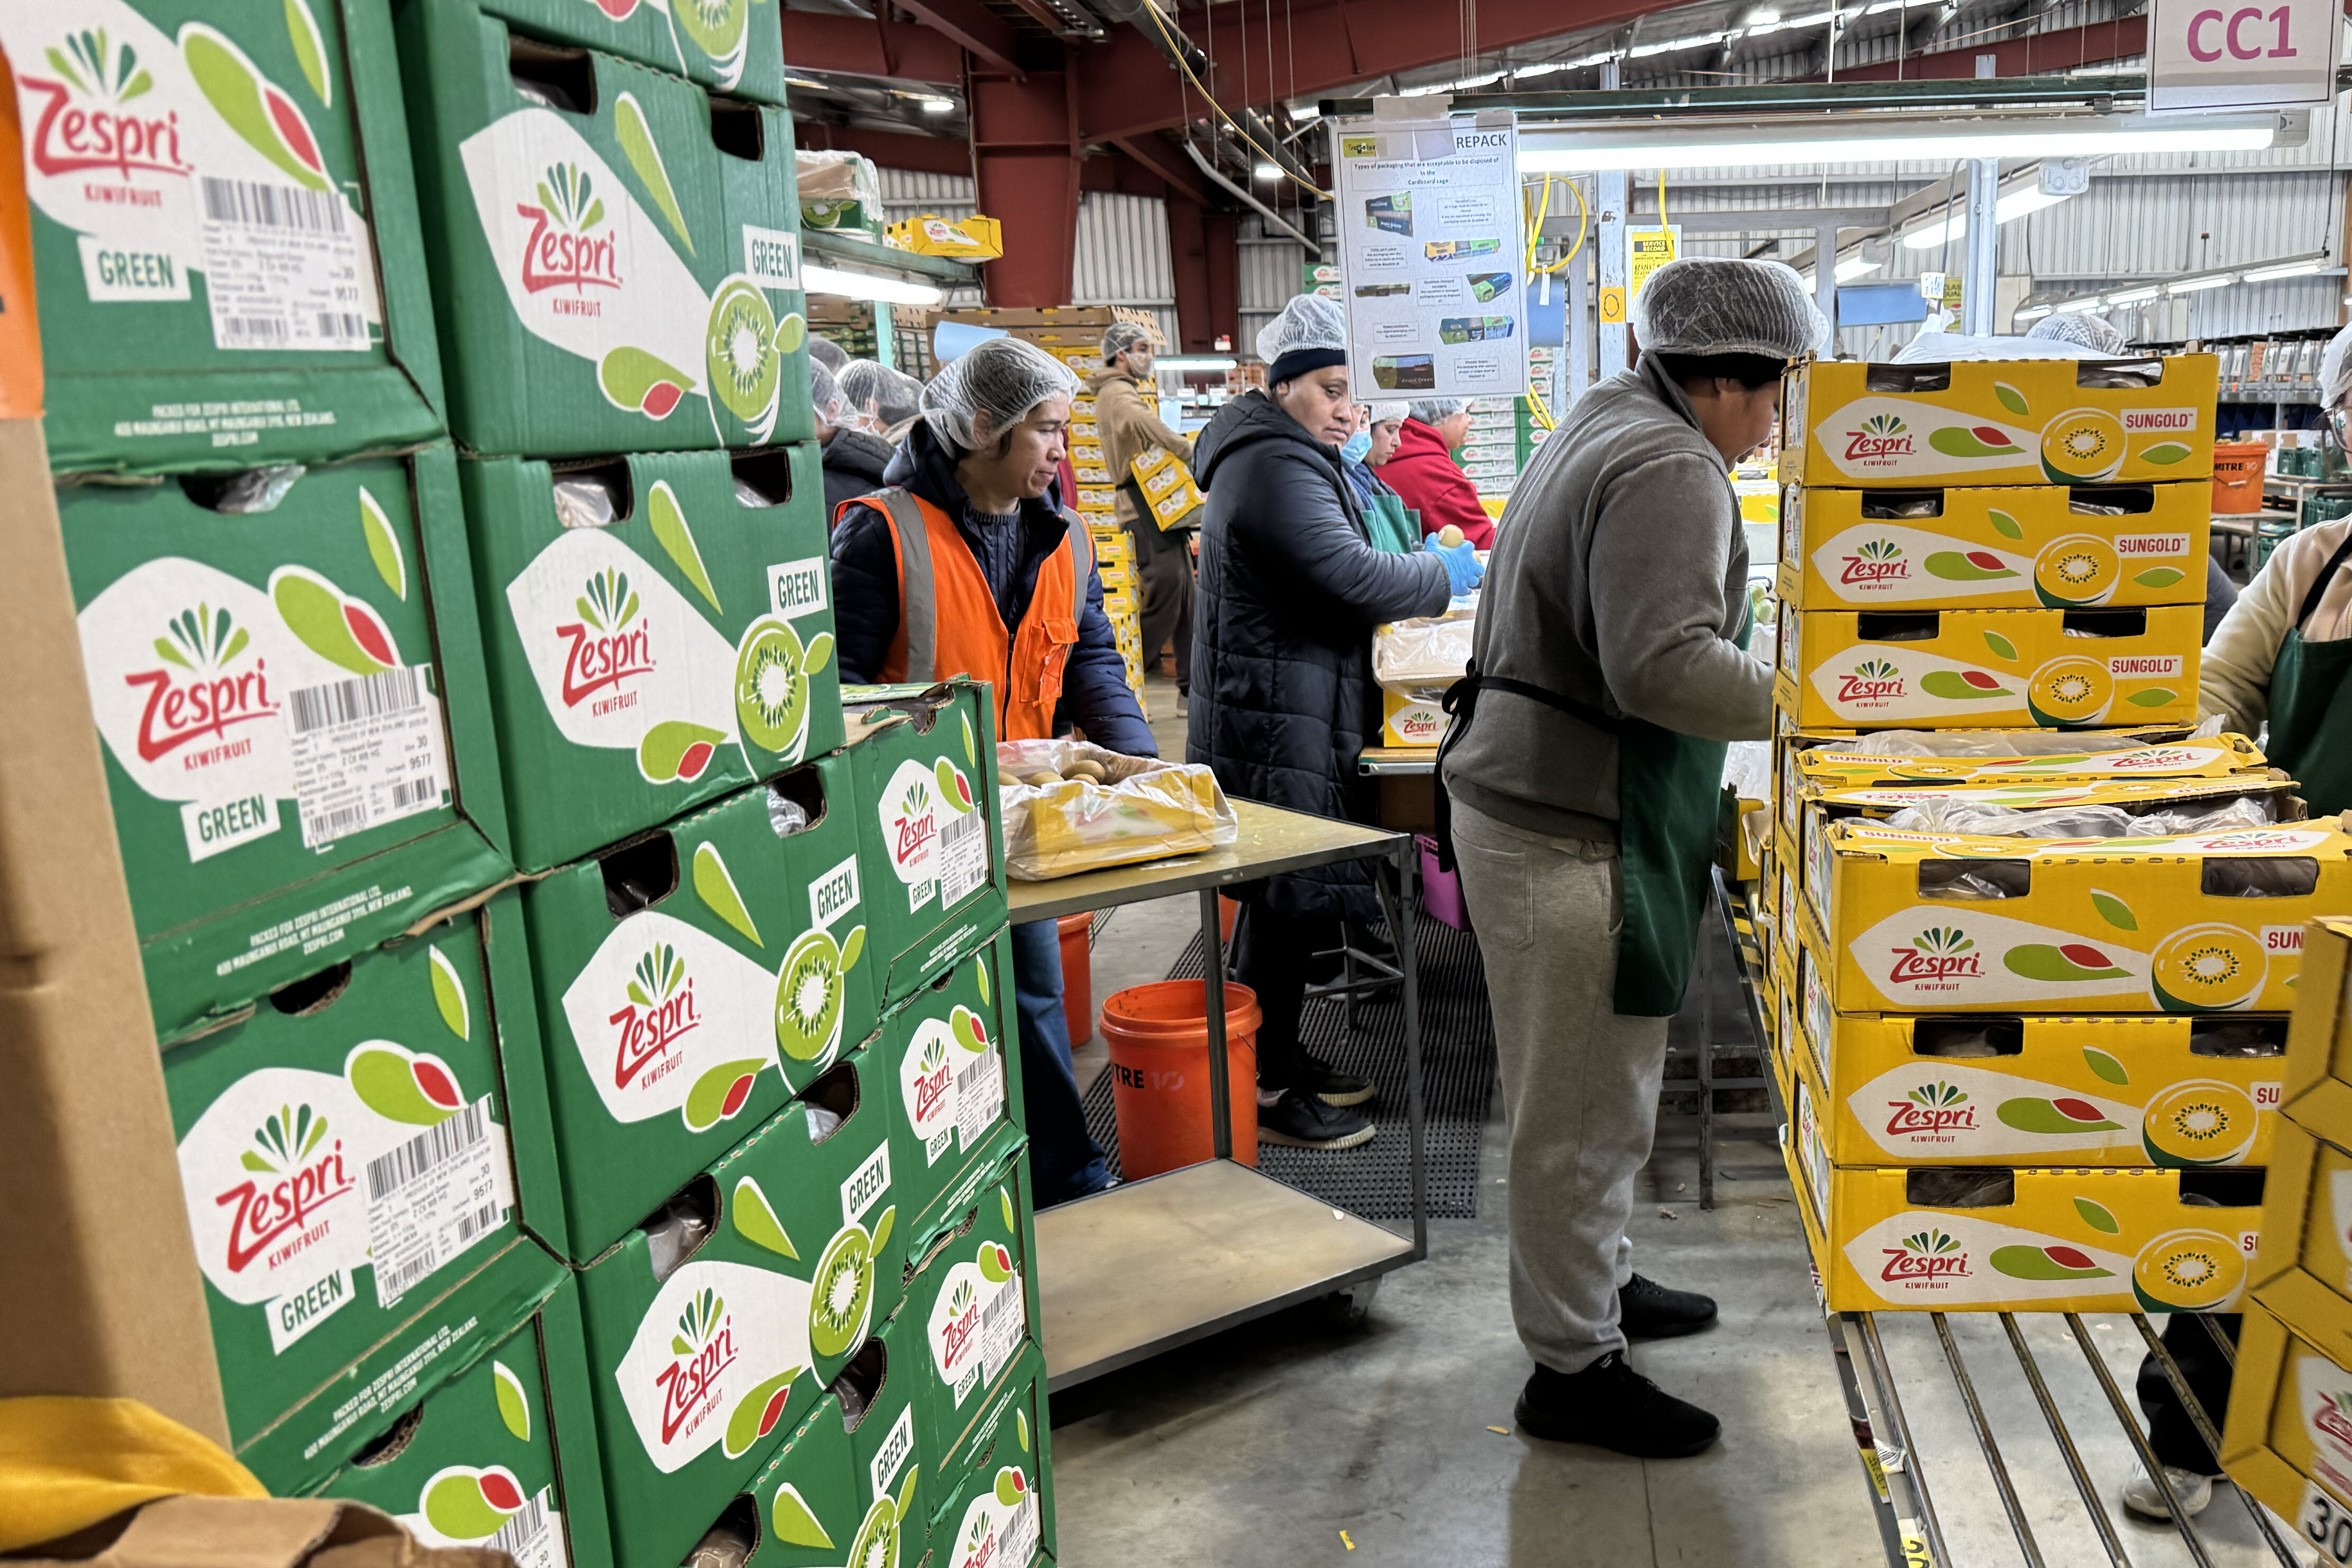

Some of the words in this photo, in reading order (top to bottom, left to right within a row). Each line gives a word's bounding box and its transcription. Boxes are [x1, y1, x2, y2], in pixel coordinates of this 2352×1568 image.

[2187, 6, 2297, 62] CC1
[18, 74, 190, 181] Zespri
[1456, 133, 1507, 149] REPACK
[517, 202, 622, 294] Zespri
[752, 239, 793, 279] GREEN
[97, 250, 175, 289] GREEN
[552, 298, 601, 317] KIWIFRUIT
[2126, 413, 2188, 429] SUNGOLD
[1845, 431, 1913, 460] Zespri
[2119, 539, 2181, 553] SUNGOLD
[1841, 557, 1910, 584] Zespri
[778, 570, 818, 609] GREEN
[556, 617, 654, 708] Zespri
[2112, 659, 2172, 673] SUNGOLD
[592, 691, 638, 717] KIWIFRUIT
[1838, 676, 1906, 702] Zespri
[124, 657, 279, 763] Zespri
[1403, 720, 1437, 734] Zespri
[183, 738, 252, 772] KIWIFRUIT
[1830, 755, 1902, 764] SUNGOLD
[2107, 752, 2201, 767] Zespri
[198, 795, 267, 843] GREEN
[895, 807, 936, 864] Zespri
[1864, 831, 1950, 842] SUNGOLD
[2195, 836, 2308, 849] Zespri
[817, 869, 853, 919] GREEN
[913, 878, 932, 903] GREEN
[1891, 949, 1982, 983] Zespri
[1915, 983, 1961, 992] KIWIFRUIT
[609, 978, 699, 1089] Zespri
[642, 1051, 683, 1090] KIWIFRUIT
[914, 1056, 953, 1123] Zespri
[1886, 1101, 1976, 1135] Zespri
[930, 1127, 949, 1157] GREEN
[1911, 1135, 1956, 1143] KIWIFRUIT
[481, 1163, 490, 1178] 30
[850, 1156, 884, 1215] GREEN
[215, 1138, 353, 1274] Zespri
[474, 1179, 493, 1200] 9577
[267, 1219, 331, 1270] KIWIFRUIT
[1881, 1248, 1969, 1281] Zespri
[280, 1270, 343, 1334] GREEN
[1906, 1281, 1949, 1289] KIWIFRUIT
[943, 1296, 979, 1369] Zespri
[655, 1315, 736, 1445] Zespri
[958, 1364, 976, 1398] GREEN
[685, 1388, 723, 1439] KIWIFRUIT
[878, 1420, 907, 1488] GREEN
[2307, 1497, 2352, 1564] 30
[540, 1551, 549, 1565] 30
